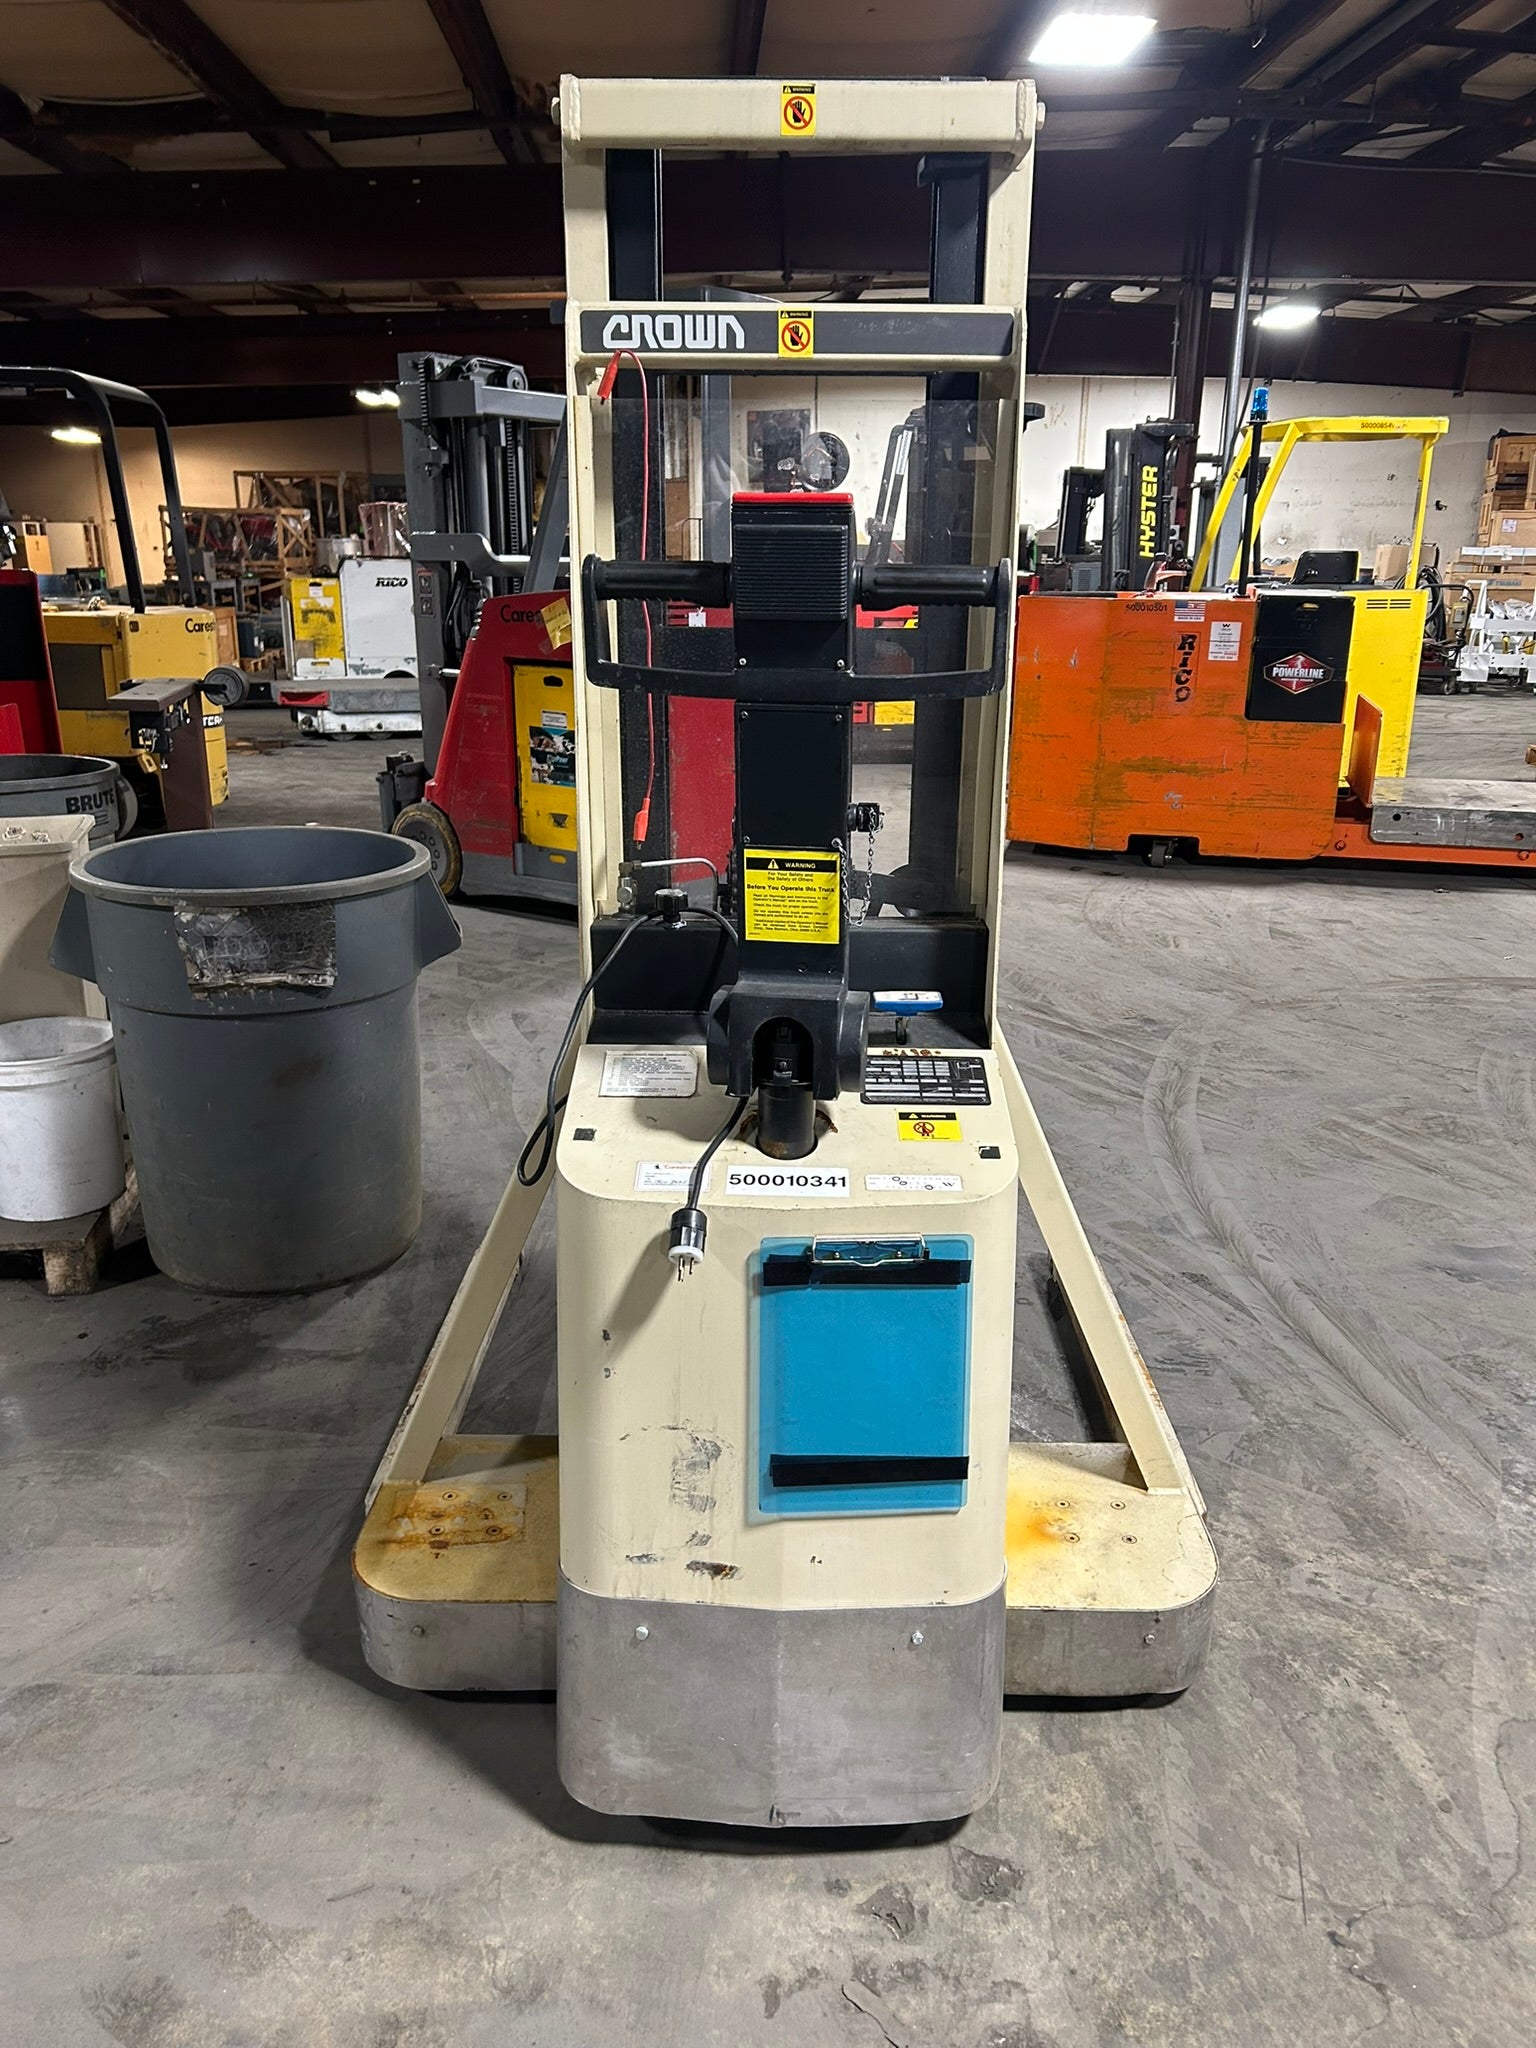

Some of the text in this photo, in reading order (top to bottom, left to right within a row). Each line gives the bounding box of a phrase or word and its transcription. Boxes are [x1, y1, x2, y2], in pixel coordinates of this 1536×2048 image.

[602, 314, 745, 349] CROWN
[1139, 465, 1158, 558] HYSTER
[375, 577, 408, 587] RICO
[1272, 667, 1324, 679] POWERLINE
[65, 788, 114, 814] BRUTE
[729, 1174, 846, 1187] 500010341
